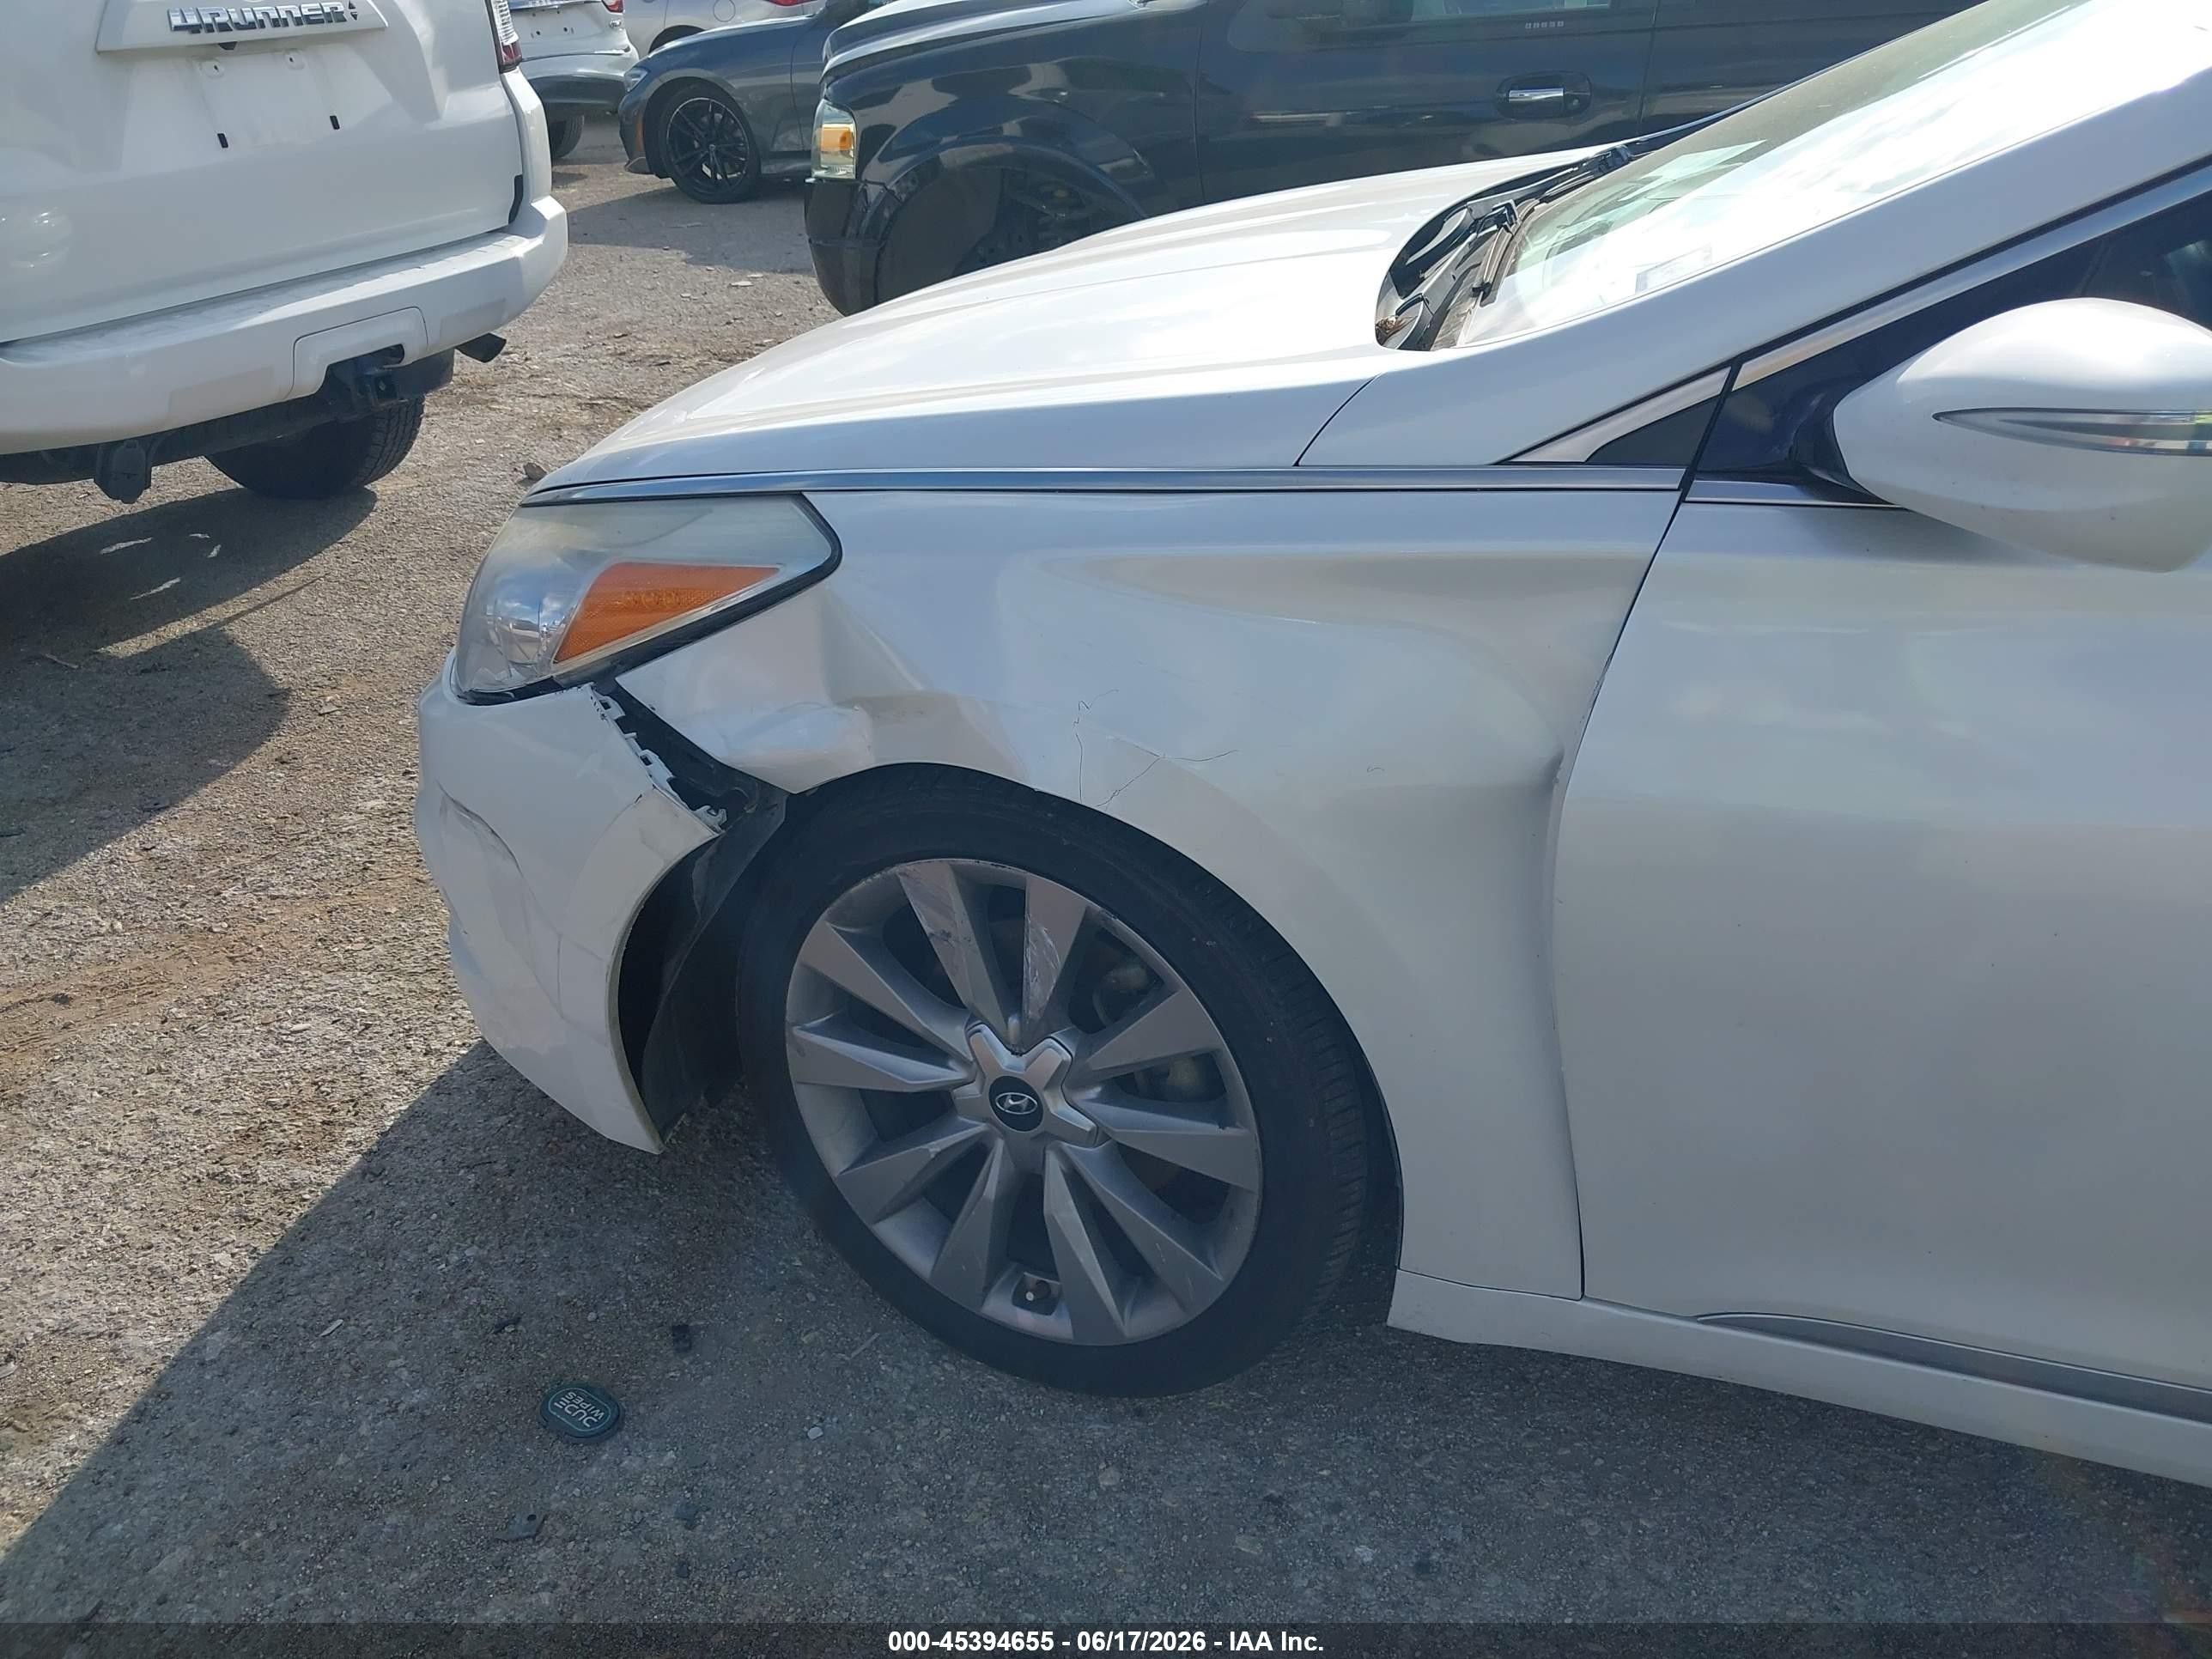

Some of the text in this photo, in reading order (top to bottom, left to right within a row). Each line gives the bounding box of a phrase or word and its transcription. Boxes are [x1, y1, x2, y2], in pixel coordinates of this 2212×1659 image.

[168, 2, 347, 34] 4RUNNER
[554, 1397, 599, 1427] DUDE
[565, 1391, 605, 1419] WIPES
